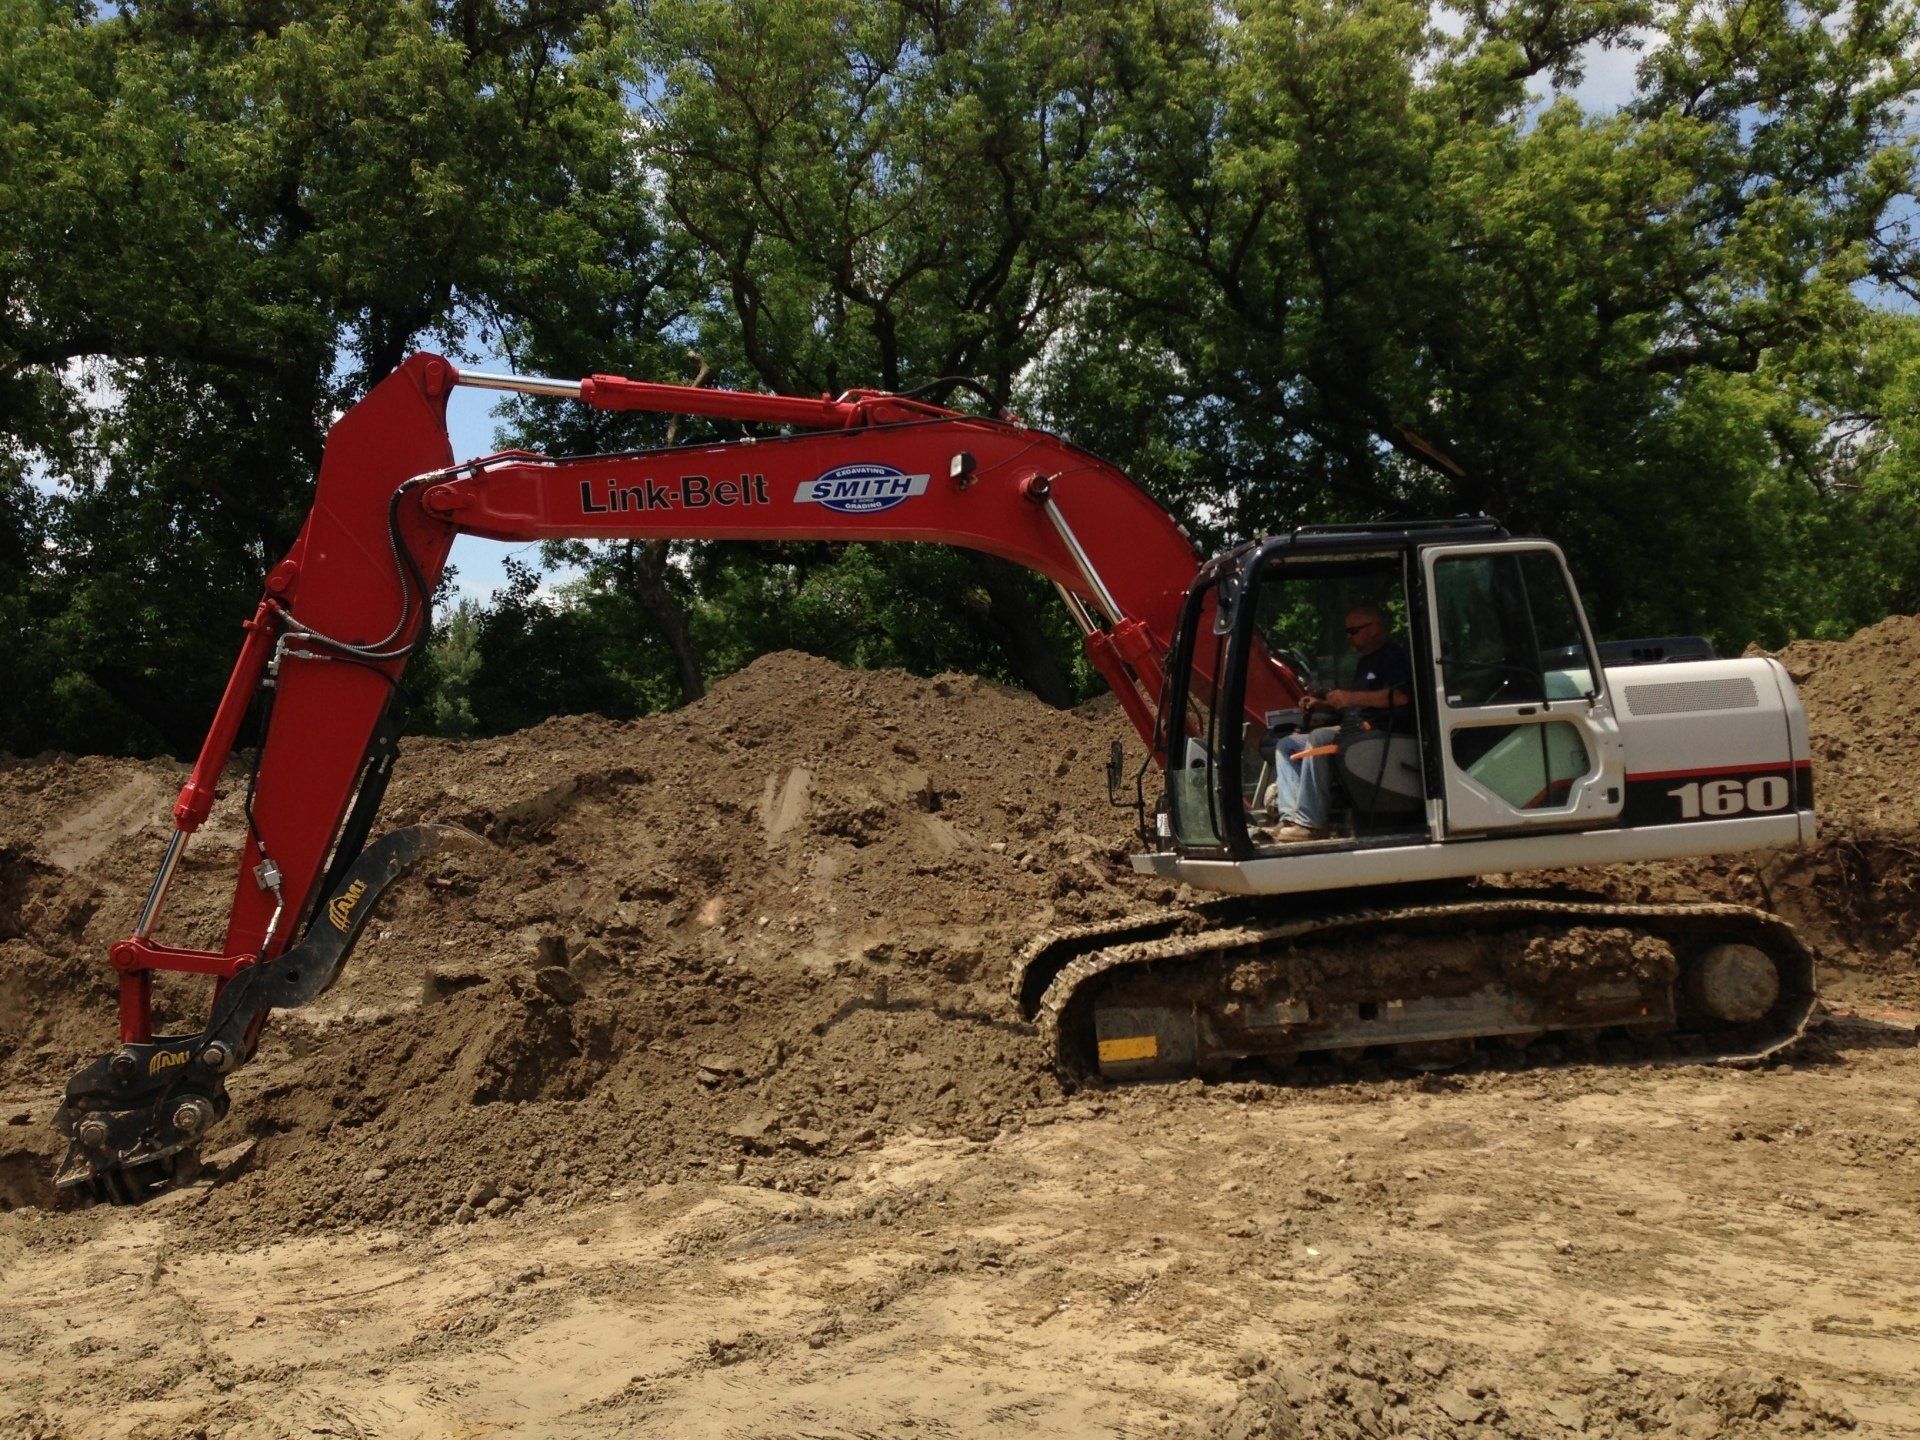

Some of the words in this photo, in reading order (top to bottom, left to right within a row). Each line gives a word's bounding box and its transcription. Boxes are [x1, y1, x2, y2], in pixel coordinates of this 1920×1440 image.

[836, 468, 885, 477] EXCAVATING
[580, 474, 769, 514] Link-Belt
[811, 478, 912, 499] SMITH
[845, 501, 882, 510] GRADING
[1667, 777, 1788, 818] 160
